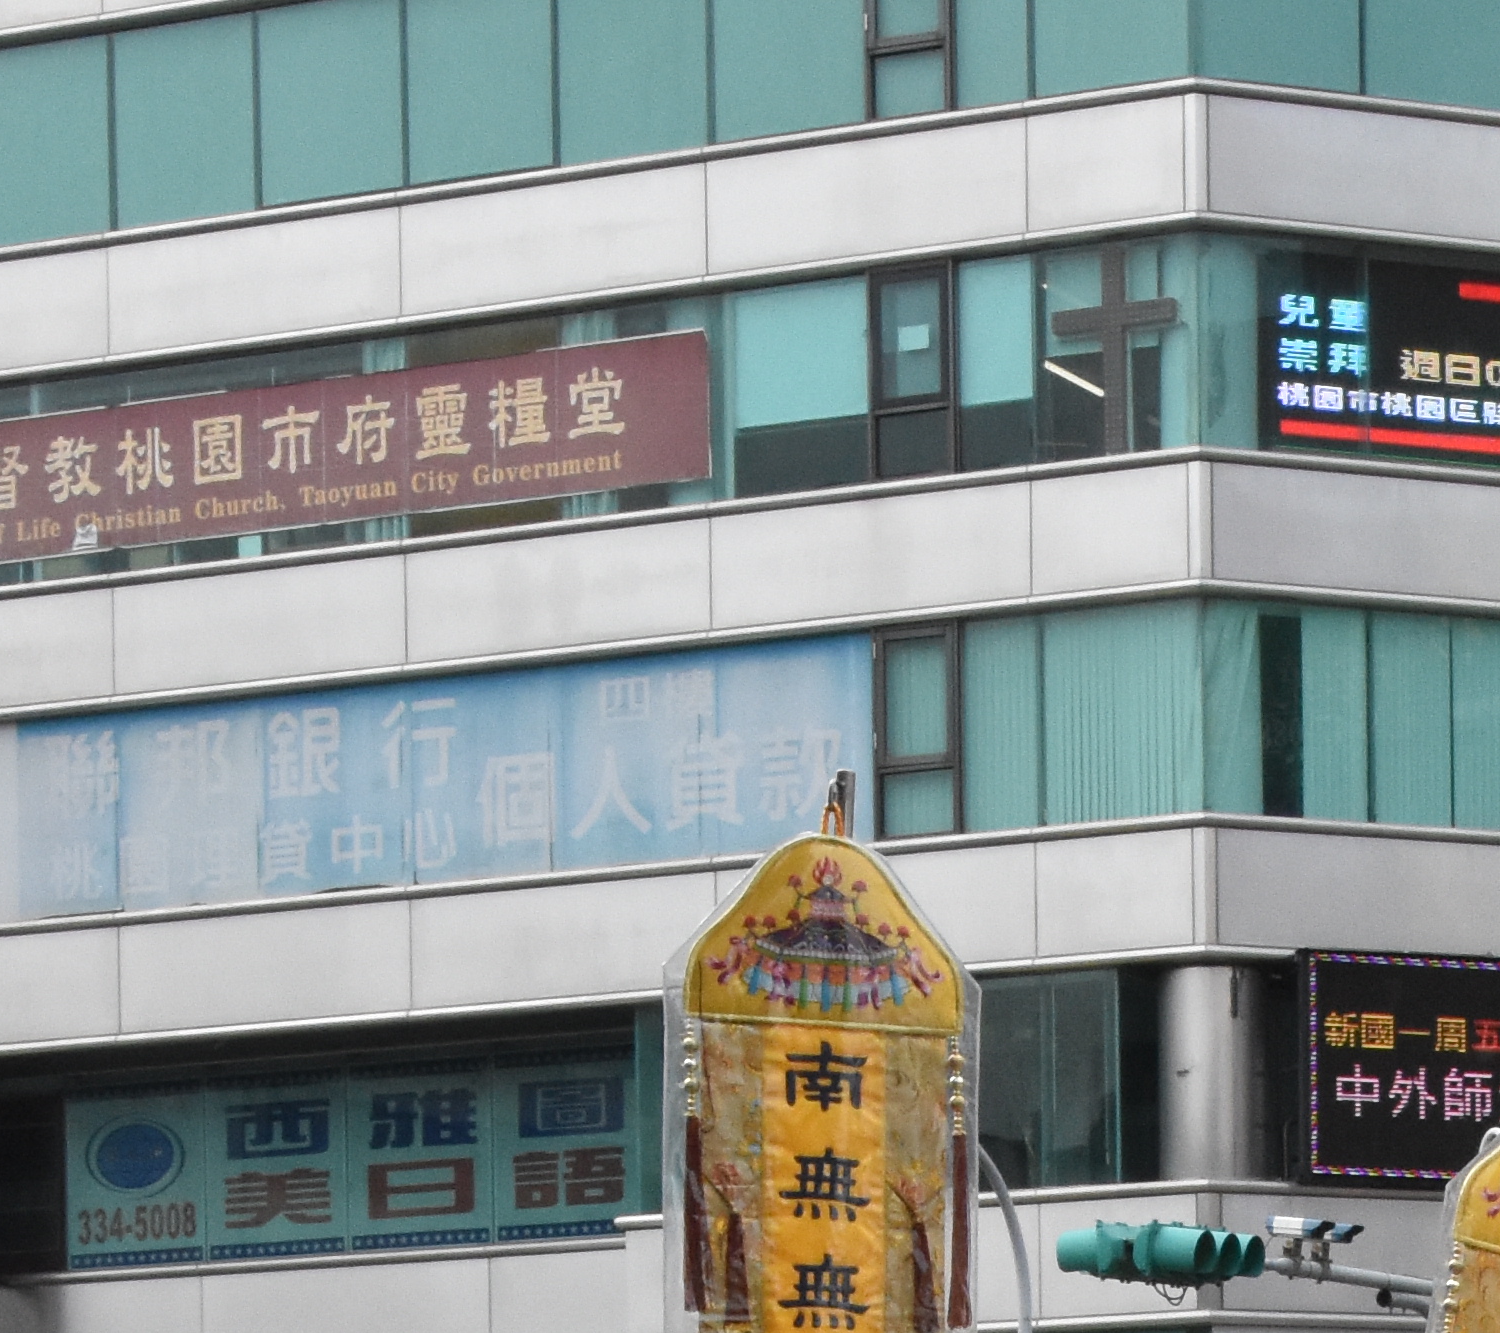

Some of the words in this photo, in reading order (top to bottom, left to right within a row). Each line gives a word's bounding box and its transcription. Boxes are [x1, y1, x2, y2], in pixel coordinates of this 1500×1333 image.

[1277, 292, 1368, 333] 兒童
[1277, 337, 1369, 377] 崇拜
[16, 518, 61, 541] Life
[74, 503, 182, 536] Christian
[194, 493, 286, 522] Church,
[299, 477, 398, 509] Taoyuan
[410, 470, 460, 499] City
[471, 448, 623, 487] Government
[44, 697, 459, 820] 聯邦銀行
[476, 728, 843, 848] 個人貸款
[224, 1076, 625, 1161] 西雅圖
[77, 1201, 197, 1246] 334-5008
[223, 1146, 626, 1230] 美日語
